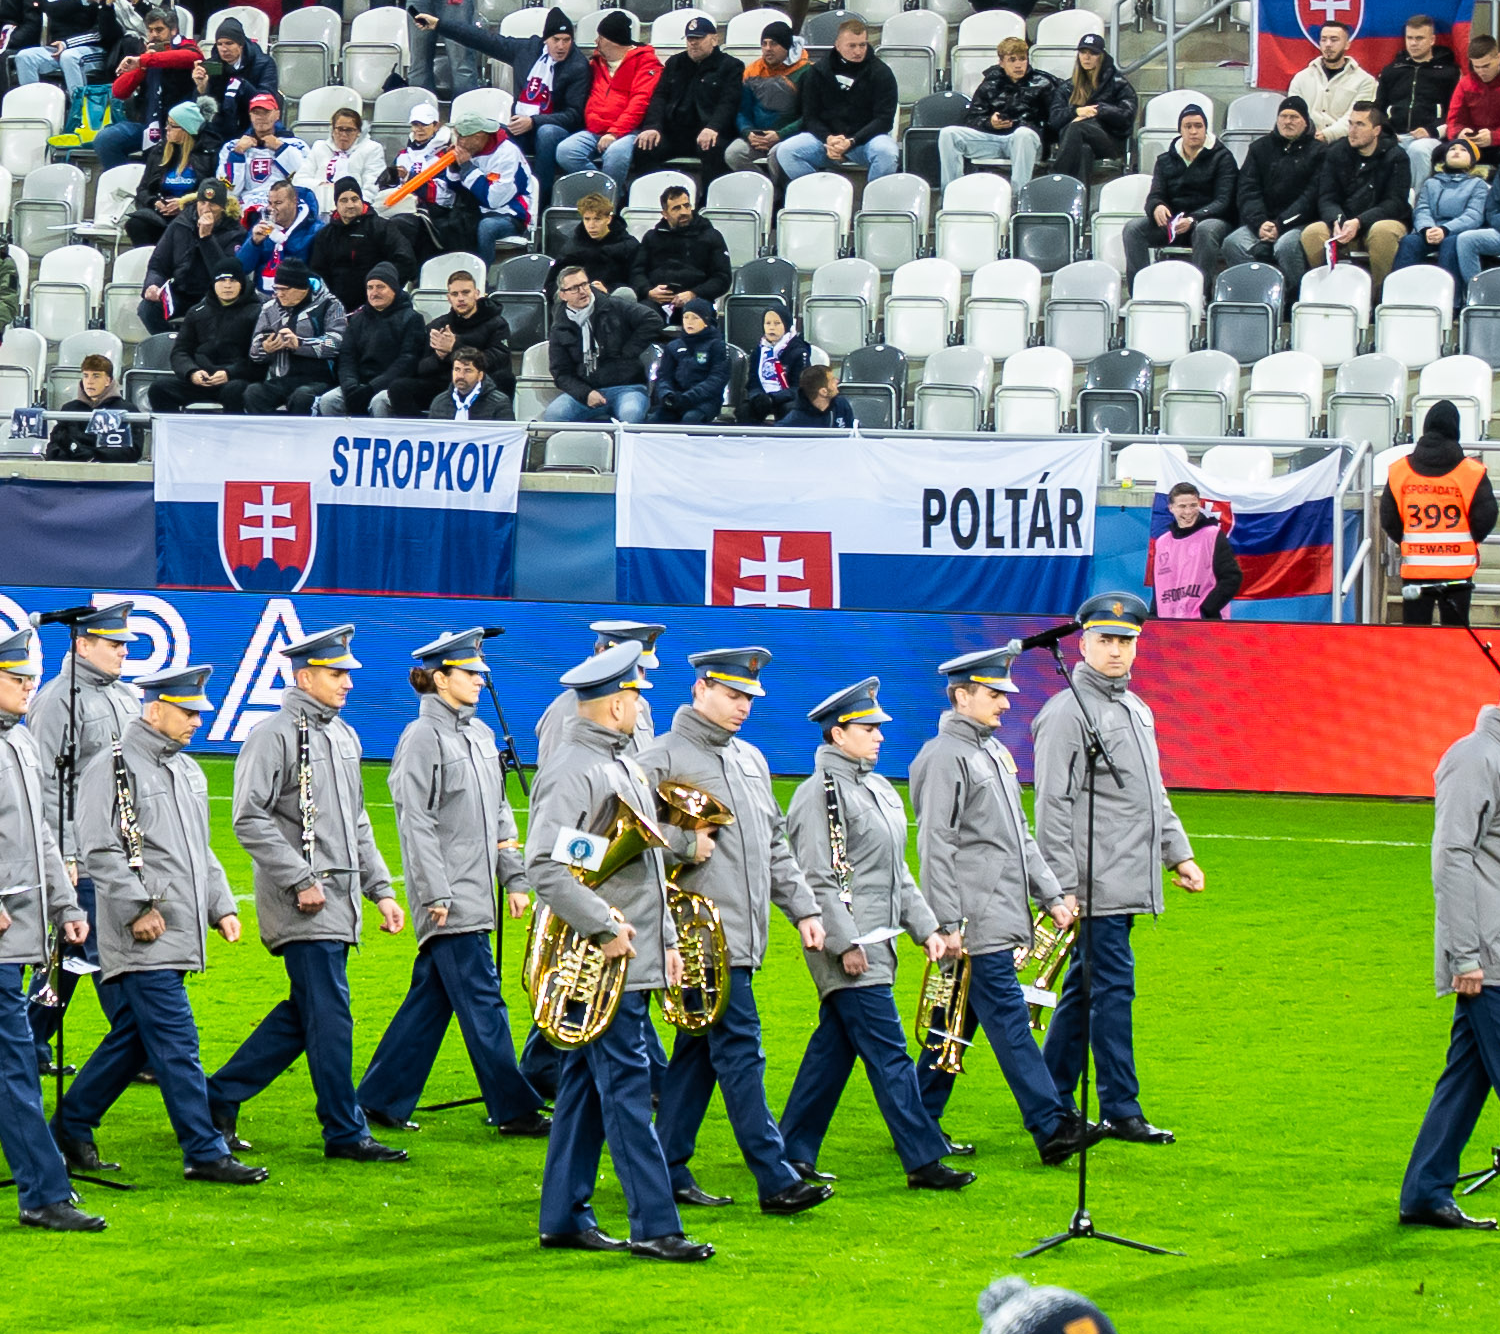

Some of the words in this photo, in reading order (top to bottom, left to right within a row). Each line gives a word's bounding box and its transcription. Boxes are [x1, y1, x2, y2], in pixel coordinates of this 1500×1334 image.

[329, 435, 505, 494] STROPKOV
[921, 471, 1084, 551] POLTÁR
[1407, 504, 1461, 530] 399
[1407, 544, 1461, 555] STEWARD
